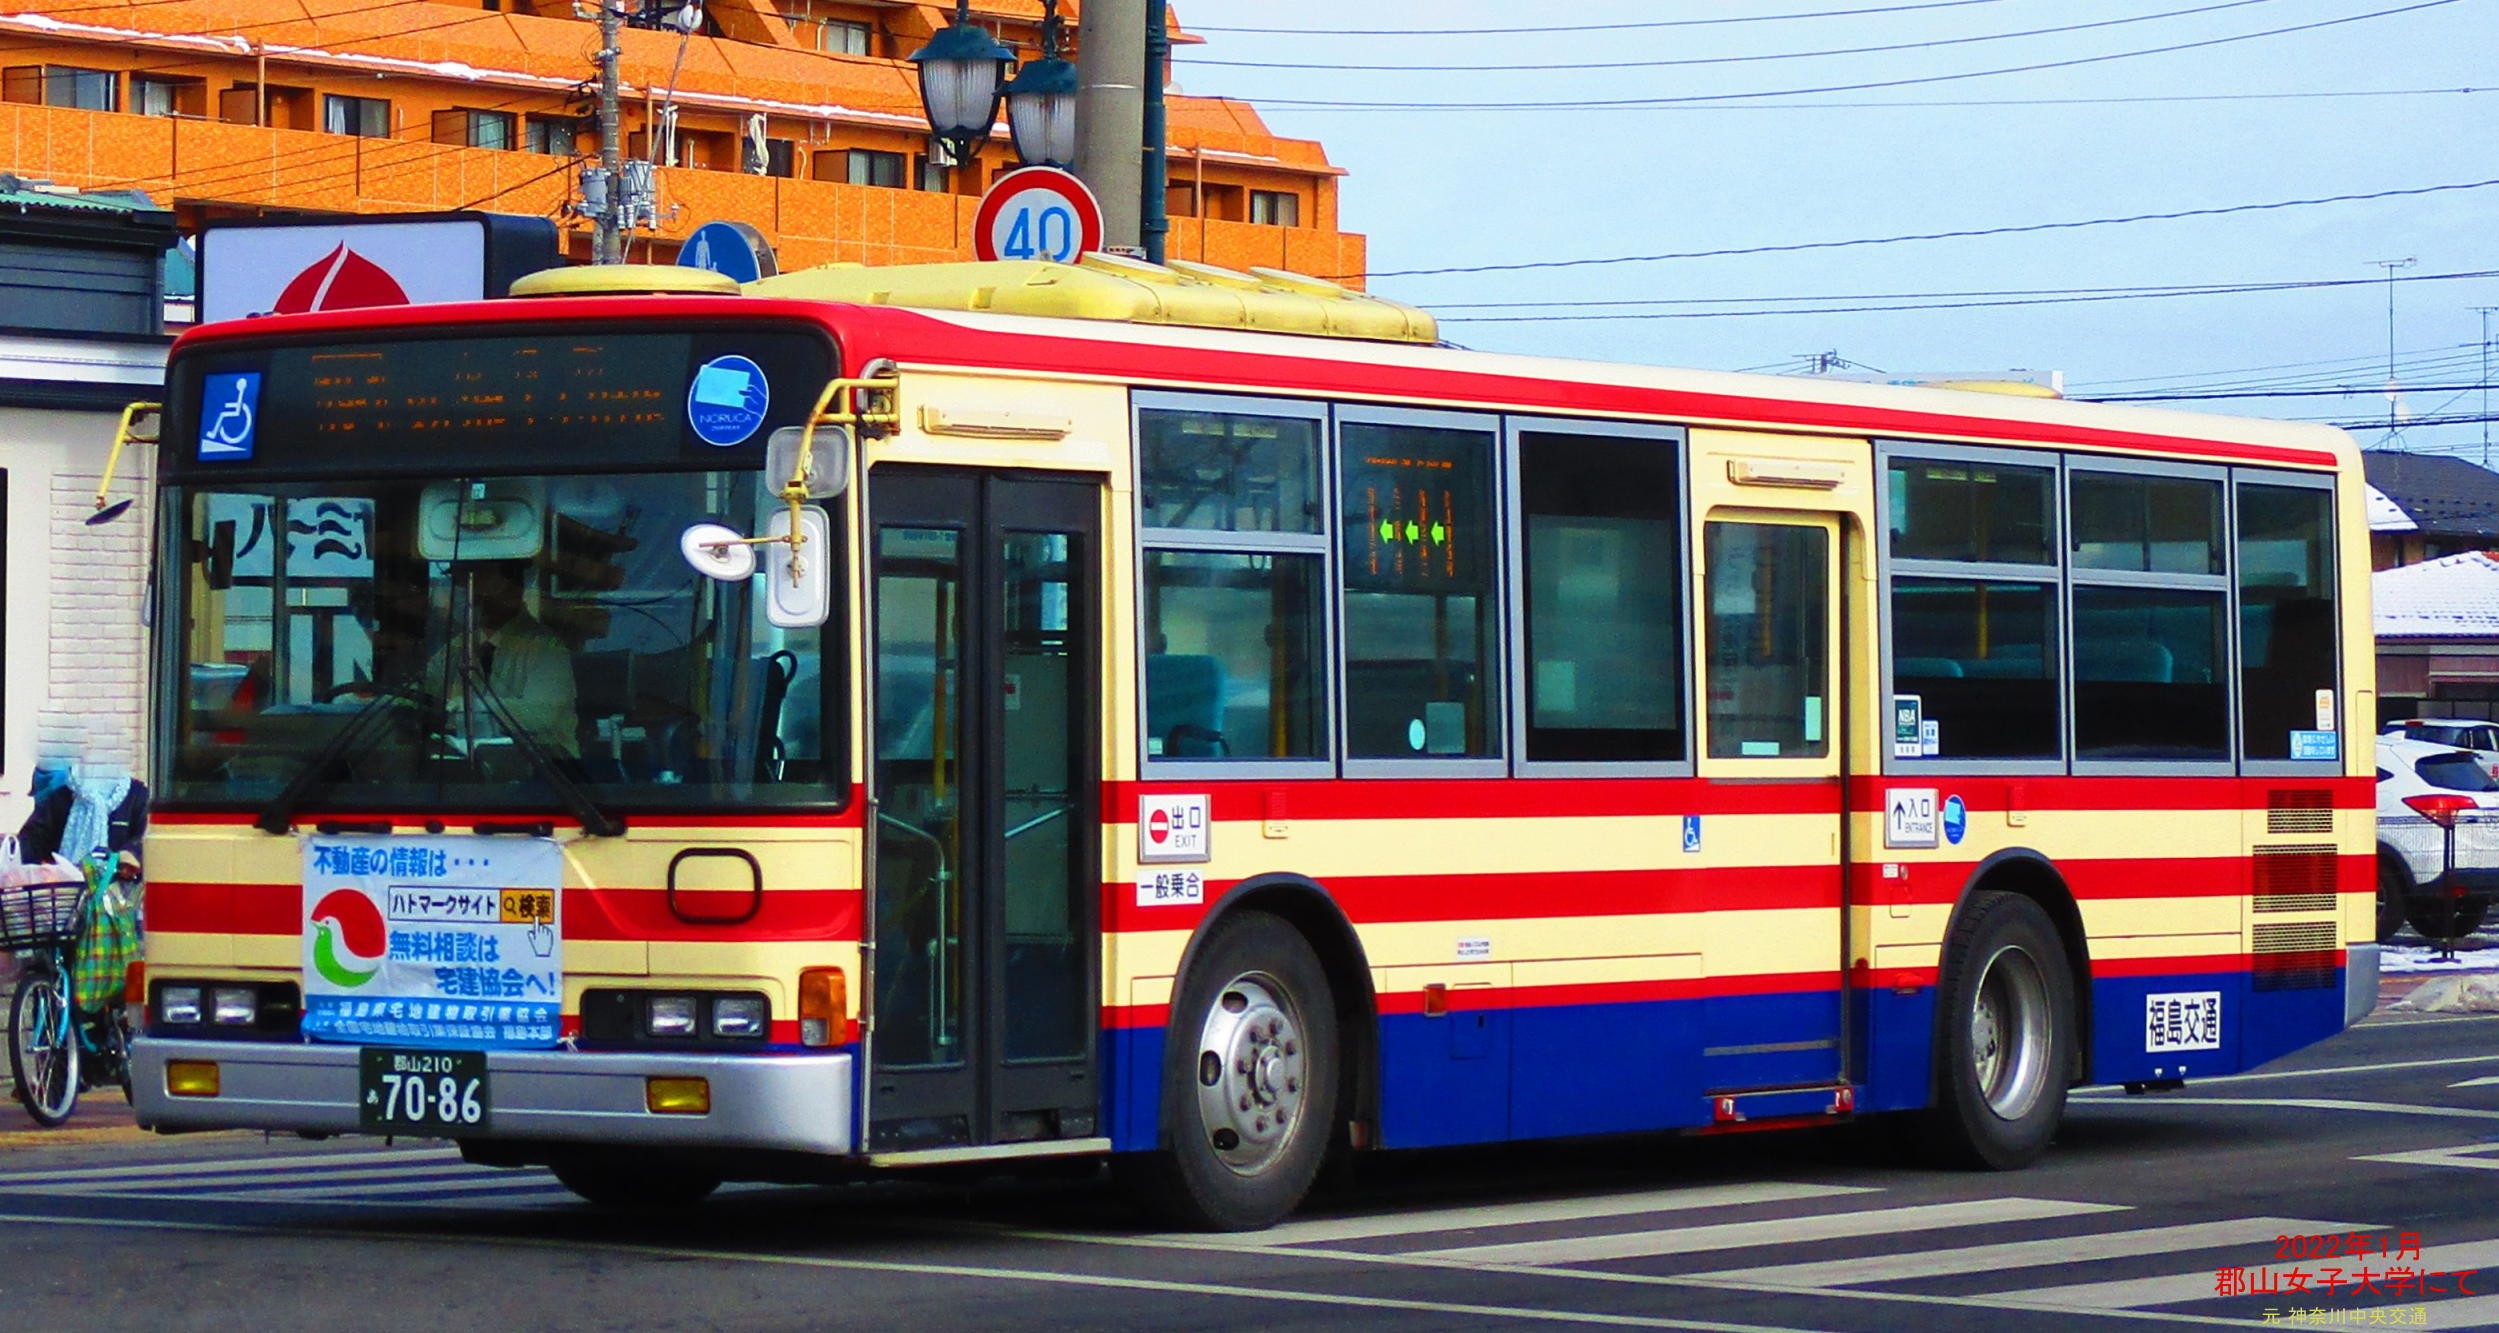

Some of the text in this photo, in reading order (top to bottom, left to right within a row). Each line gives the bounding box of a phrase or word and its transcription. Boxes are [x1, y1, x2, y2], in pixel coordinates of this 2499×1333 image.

[1004, 206, 1071, 262] 40
[1171, 805, 1201, 829] 出口
[1908, 798, 1930, 818] 入口
[1175, 834, 1197, 848] EXIT
[1904, 822, 1933, 834] ENTRANCE
[1140, 872, 1200, 899] 一般乗合
[392, 893, 551, 918] ハトマークサイト 検索
[388, 930, 500, 963] 無料相談は
[2149, 998, 2217, 1047] 福島交通
[382, 1074, 481, 1123] 70-86
